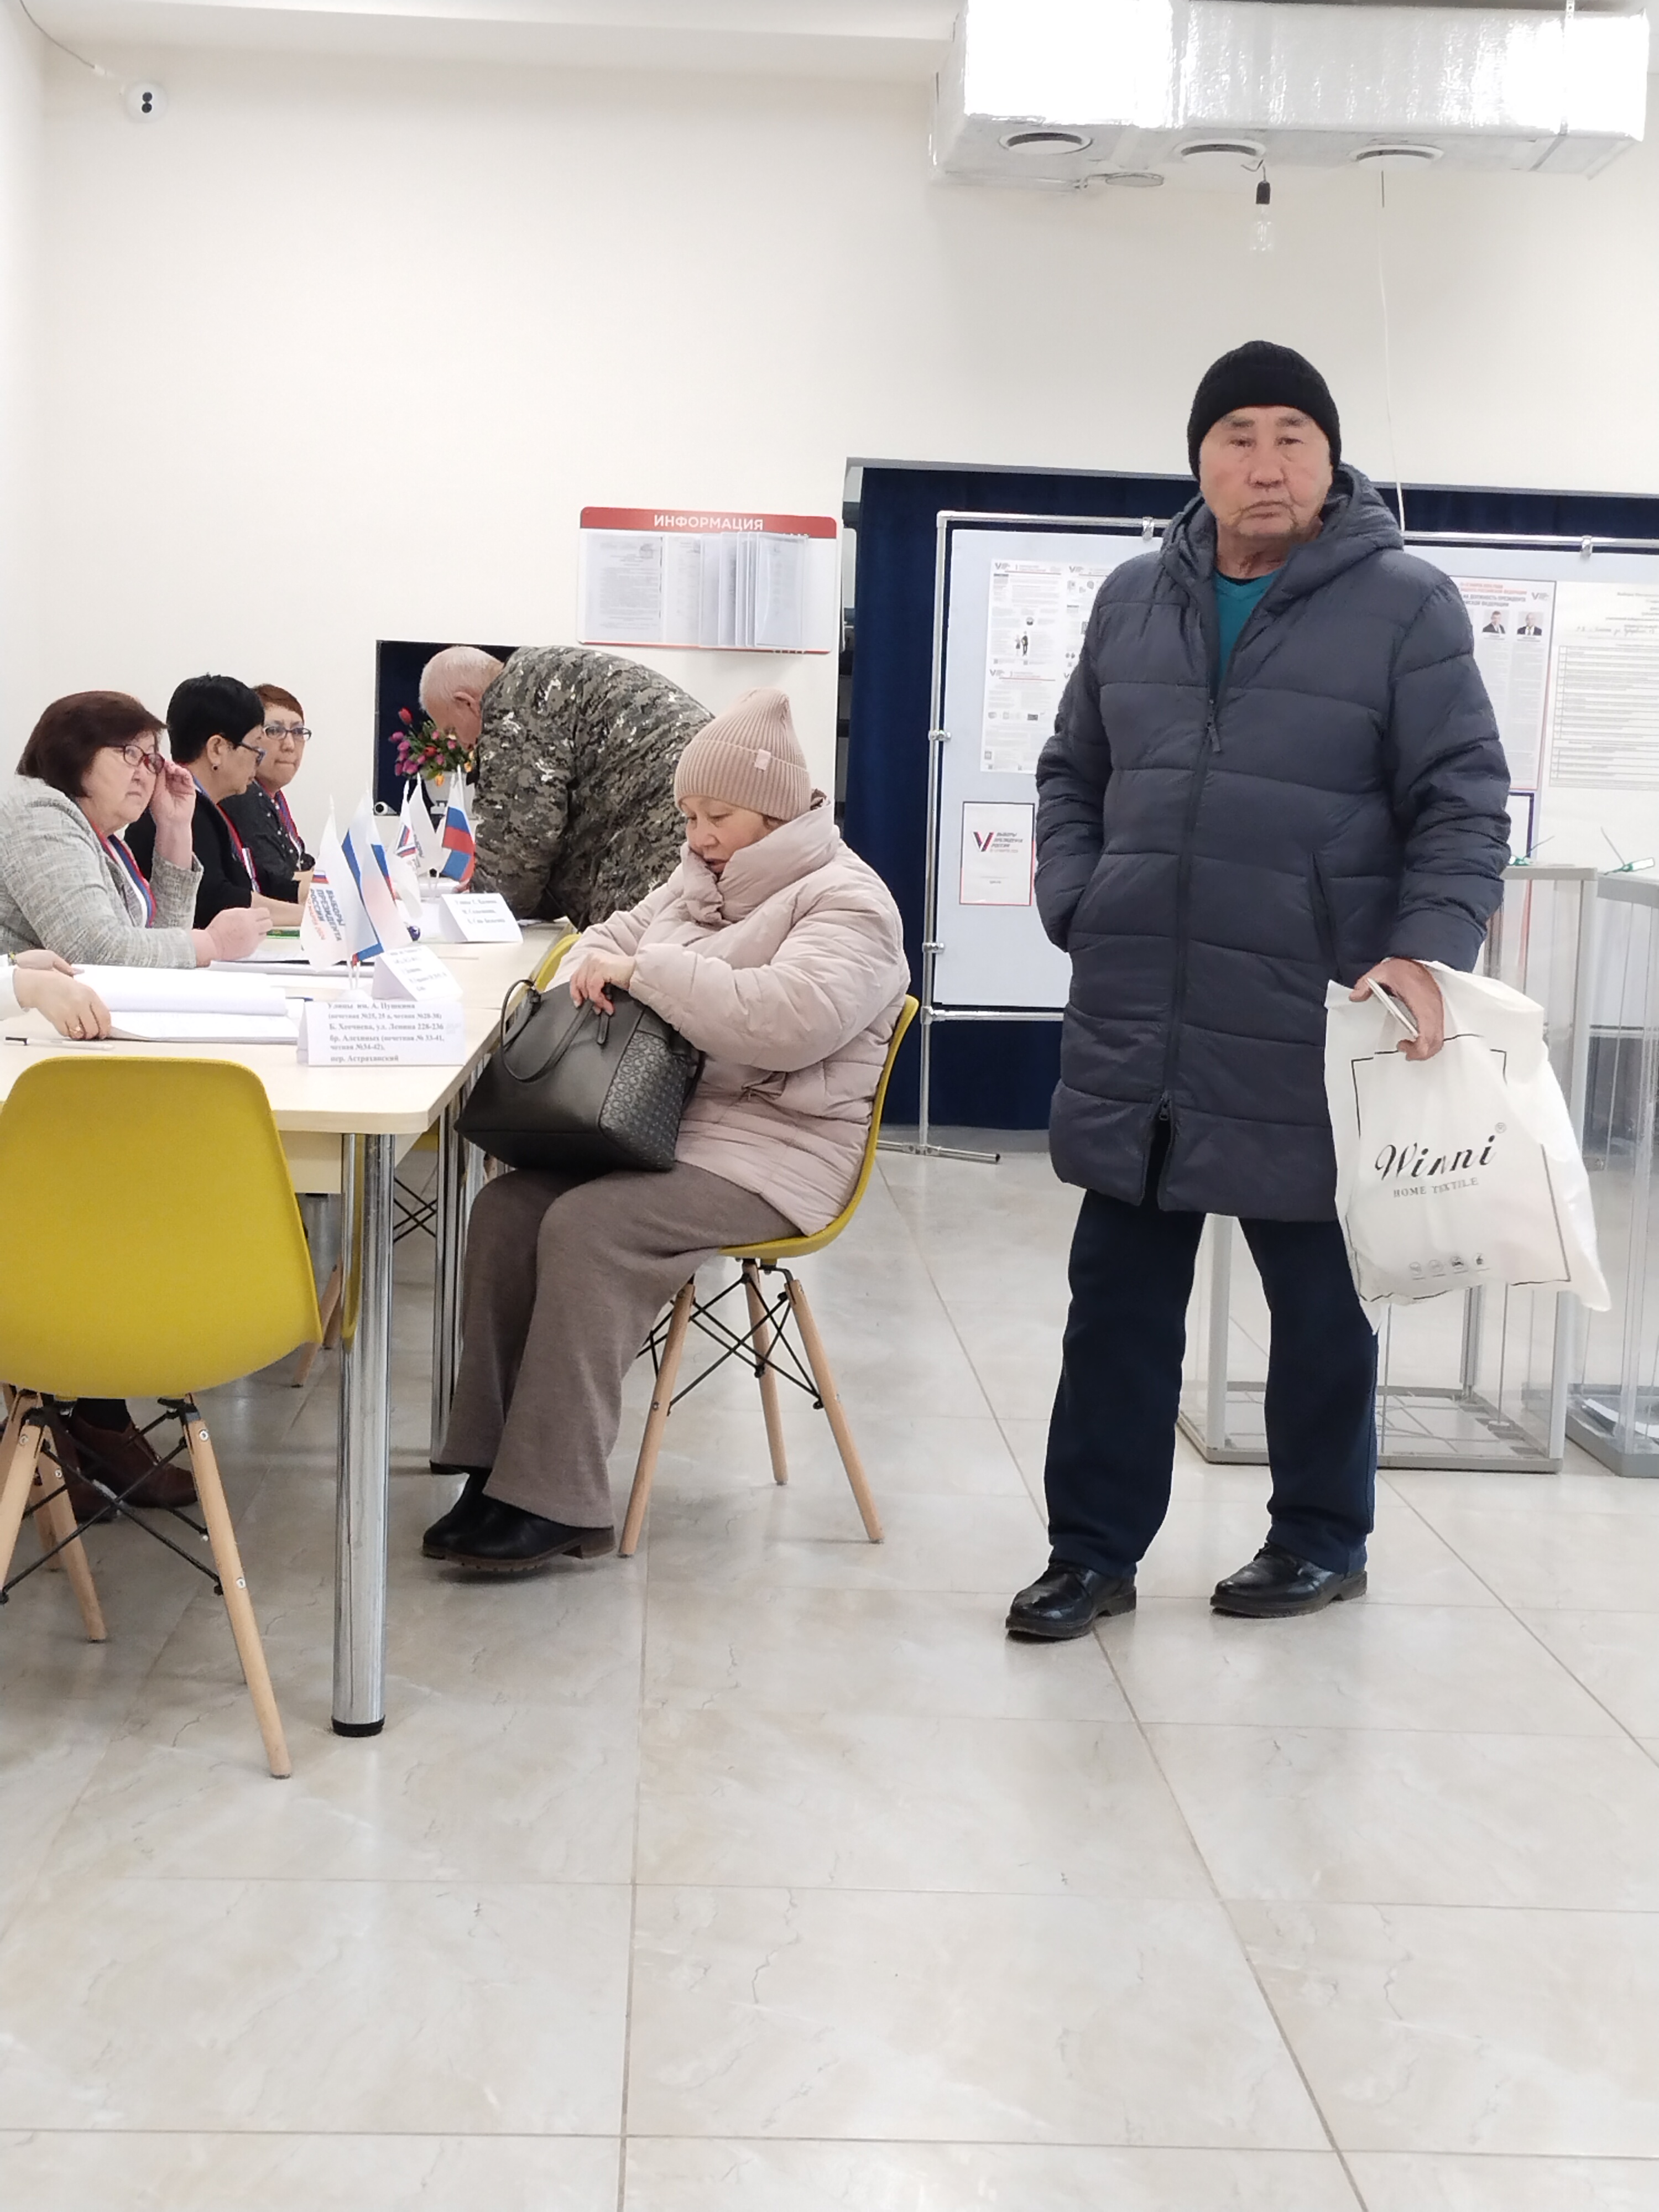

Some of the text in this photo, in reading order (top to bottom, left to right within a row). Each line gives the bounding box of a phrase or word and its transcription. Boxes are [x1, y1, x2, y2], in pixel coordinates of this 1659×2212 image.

[654, 514, 763, 531] ИНФОРМАЦИЯ
[310, 888, 326, 921] РОССИИ
[316, 889, 342, 941] ПРЕЗИДЕНТА
[326, 889, 346, 926] ВЫБОРЫ
[380, 1002, 415, 1010] Пушкина
[330, 1034, 341, 1043] бр.
[348, 1055, 399, 1063] Астраханский
[1375, 1135, 1496, 1181] Winni
[1393, 1177, 1479, 1198] HOME TEXTILE
